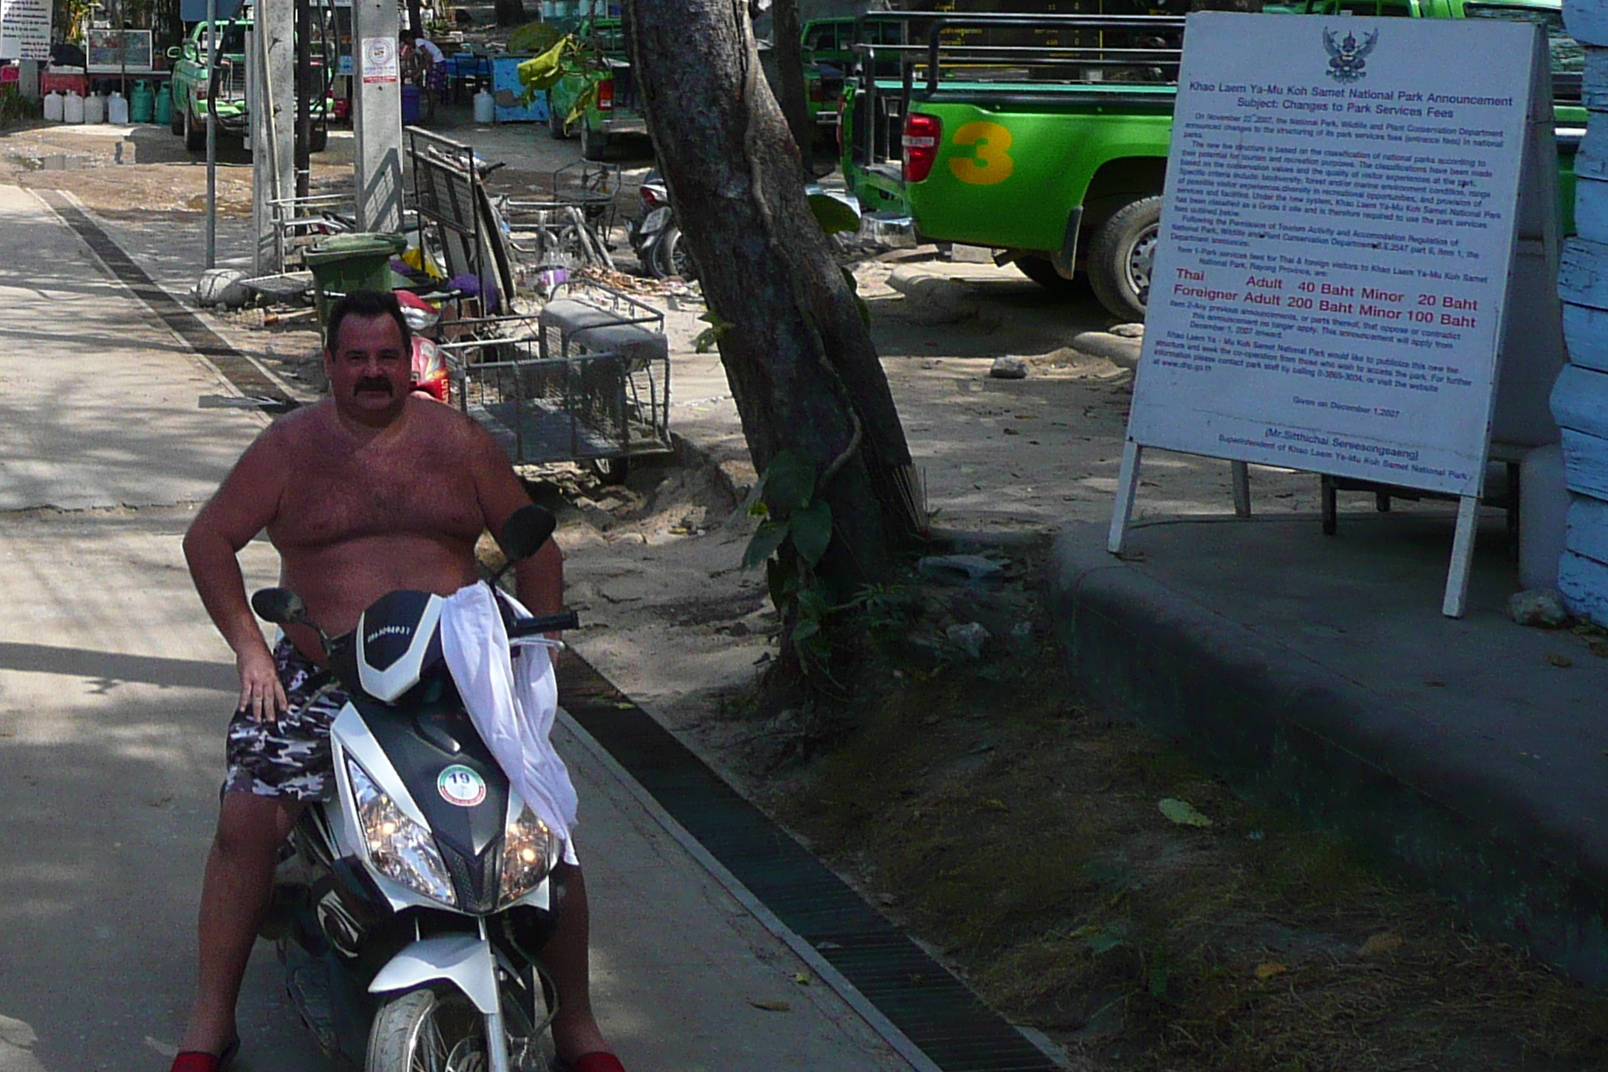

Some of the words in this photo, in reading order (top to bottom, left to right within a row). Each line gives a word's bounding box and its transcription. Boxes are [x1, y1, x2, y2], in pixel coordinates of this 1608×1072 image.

[1189, 80, 1215, 90] Khao
[1217, 82, 1247, 92] Laem
[1249, 83, 1283, 94] Ya-Mu
[1286, 85, 1308, 95] Koh
[1310, 86, 1345, 97] Samet
[1348, 88, 1394, 99] National
[1397, 90, 1423, 101] Park
[1426, 92, 1513, 105] Announcement
[1236, 96, 1279, 110] Subject:
[1281, 99, 1329, 112] Changes
[1331, 101, 1344, 111] to
[1346, 102, 1371, 113] Park
[1374, 104, 1423, 115] Services
[1426, 106, 1454, 117] Fees
[948, 122, 1014, 185] 3
[1172, 284, 1238, 303] Foreigner
[1243, 292, 1281, 305] Adult
[1286, 296, 1313, 309] 200
[1318, 300, 1353, 313] Baht
[1358, 304, 1402, 319] Minor
[1405, 309, 1434, 322] 100
[1439, 313, 1476, 327] Baht
[1175, 268, 1205, 281] Thai
[1245, 275, 1283, 289] Adult
[1296, 281, 1315, 293] 40
[1320, 283, 1355, 297] Baht
[1360, 287, 1404, 302] Minor
[1417, 293, 1437, 305] 20
[1441, 296, 1478, 310] Baht
[448, 773, 471, 785] 19
